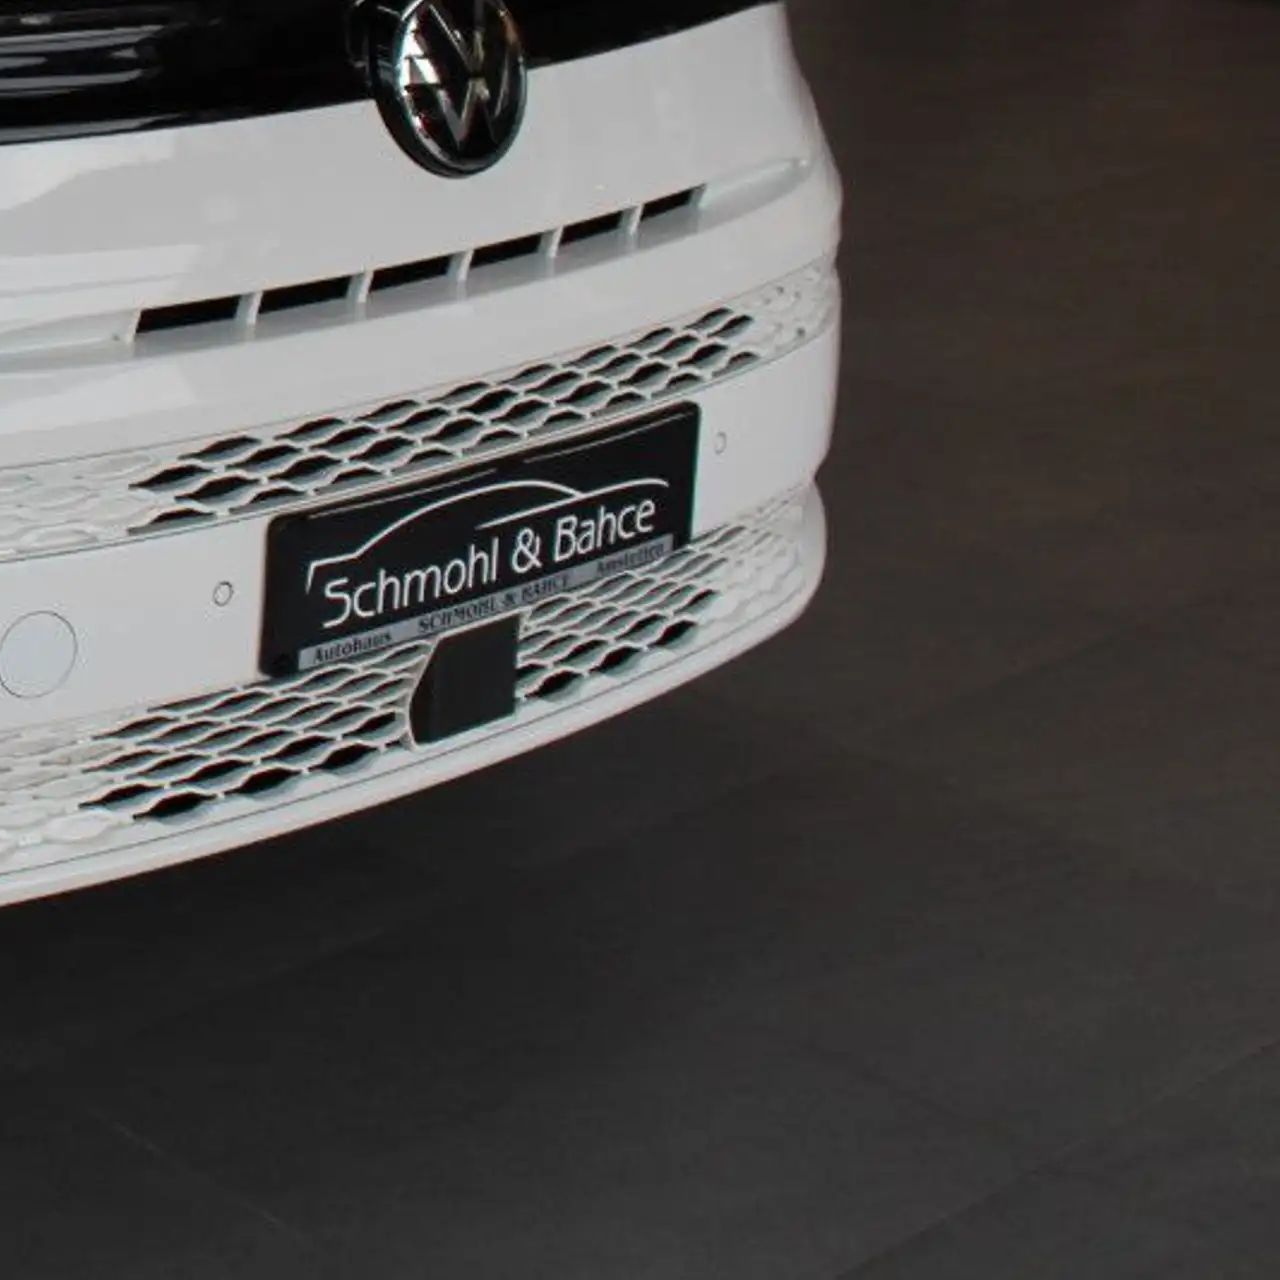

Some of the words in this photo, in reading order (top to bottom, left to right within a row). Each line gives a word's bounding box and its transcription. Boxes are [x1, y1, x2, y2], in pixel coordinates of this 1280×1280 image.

[322, 536, 499, 629] Schmohl
[512, 527, 543, 574] &
[553, 498, 655, 563] Bahce
[312, 631, 394, 665] Autohaus
[418, 598, 497, 633] SCHMOHL
